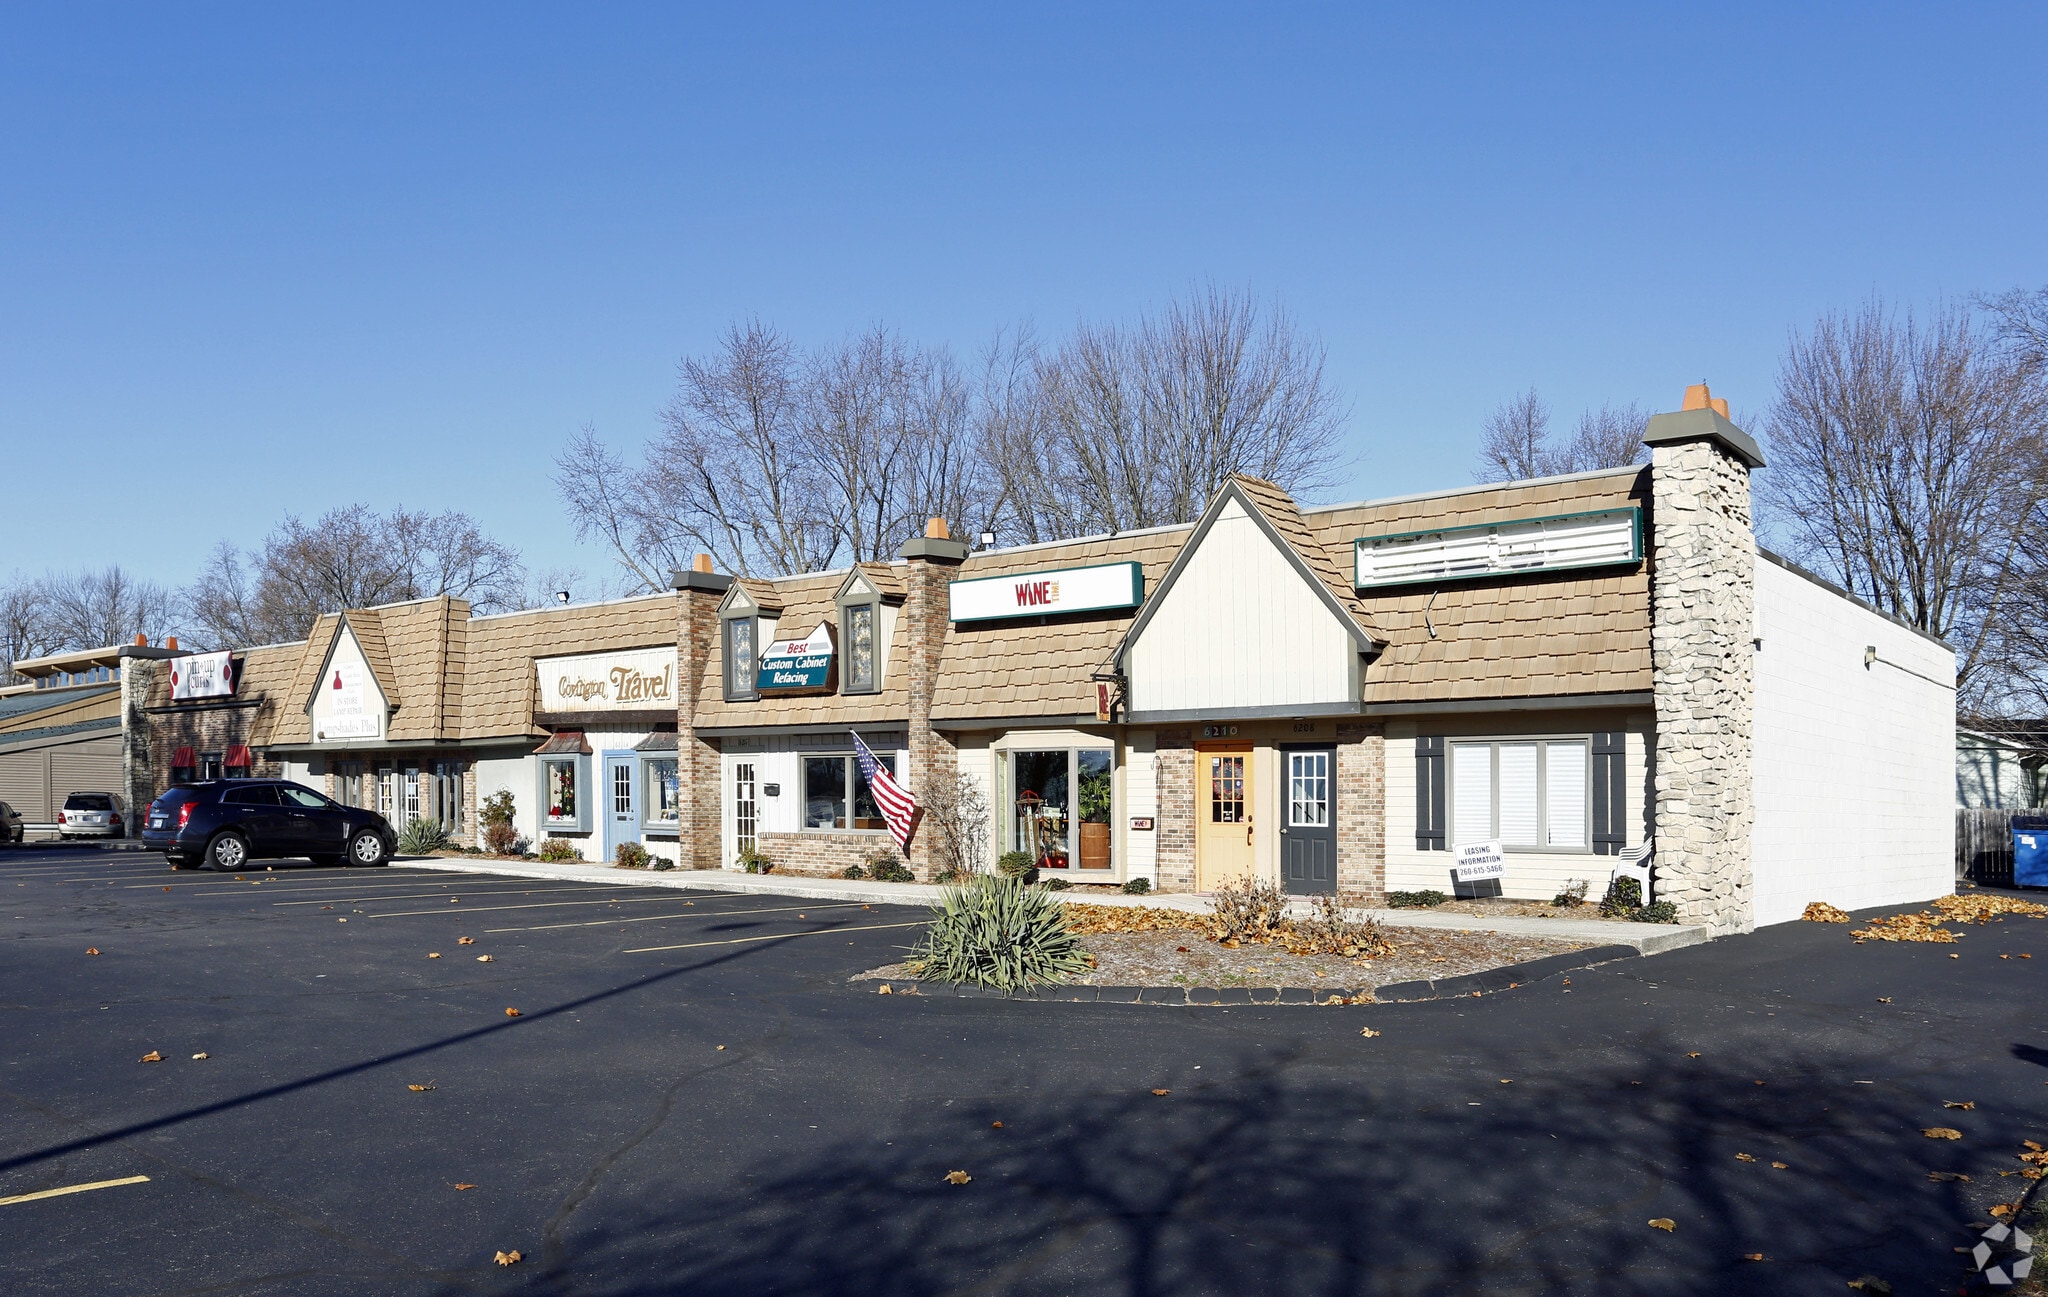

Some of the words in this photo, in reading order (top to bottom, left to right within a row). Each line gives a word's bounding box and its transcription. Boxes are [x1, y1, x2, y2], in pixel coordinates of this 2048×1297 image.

[1015, 580, 1051, 606] WINE
[787, 643, 808, 654] Best
[762, 658, 792, 670] Custom
[795, 656, 828, 669] Cabinet
[559, 675, 607, 701] Covington
[610, 663, 672, 702] Travel
[773, 672, 809, 685] Refacing
[344, 696, 358, 705] STORE
[334, 707, 346, 716] LAMP
[347, 706, 362, 715] REPAIR
[318, 719, 359, 736] Lampshades
[361, 719, 376, 733] Plus
[1204, 726, 1238, 737] 6210
[1464, 846, 1490, 855] LEASING
[1458, 855, 1501, 866] INFORMATION
[1460, 865, 1503, 876] 260-615-5466
